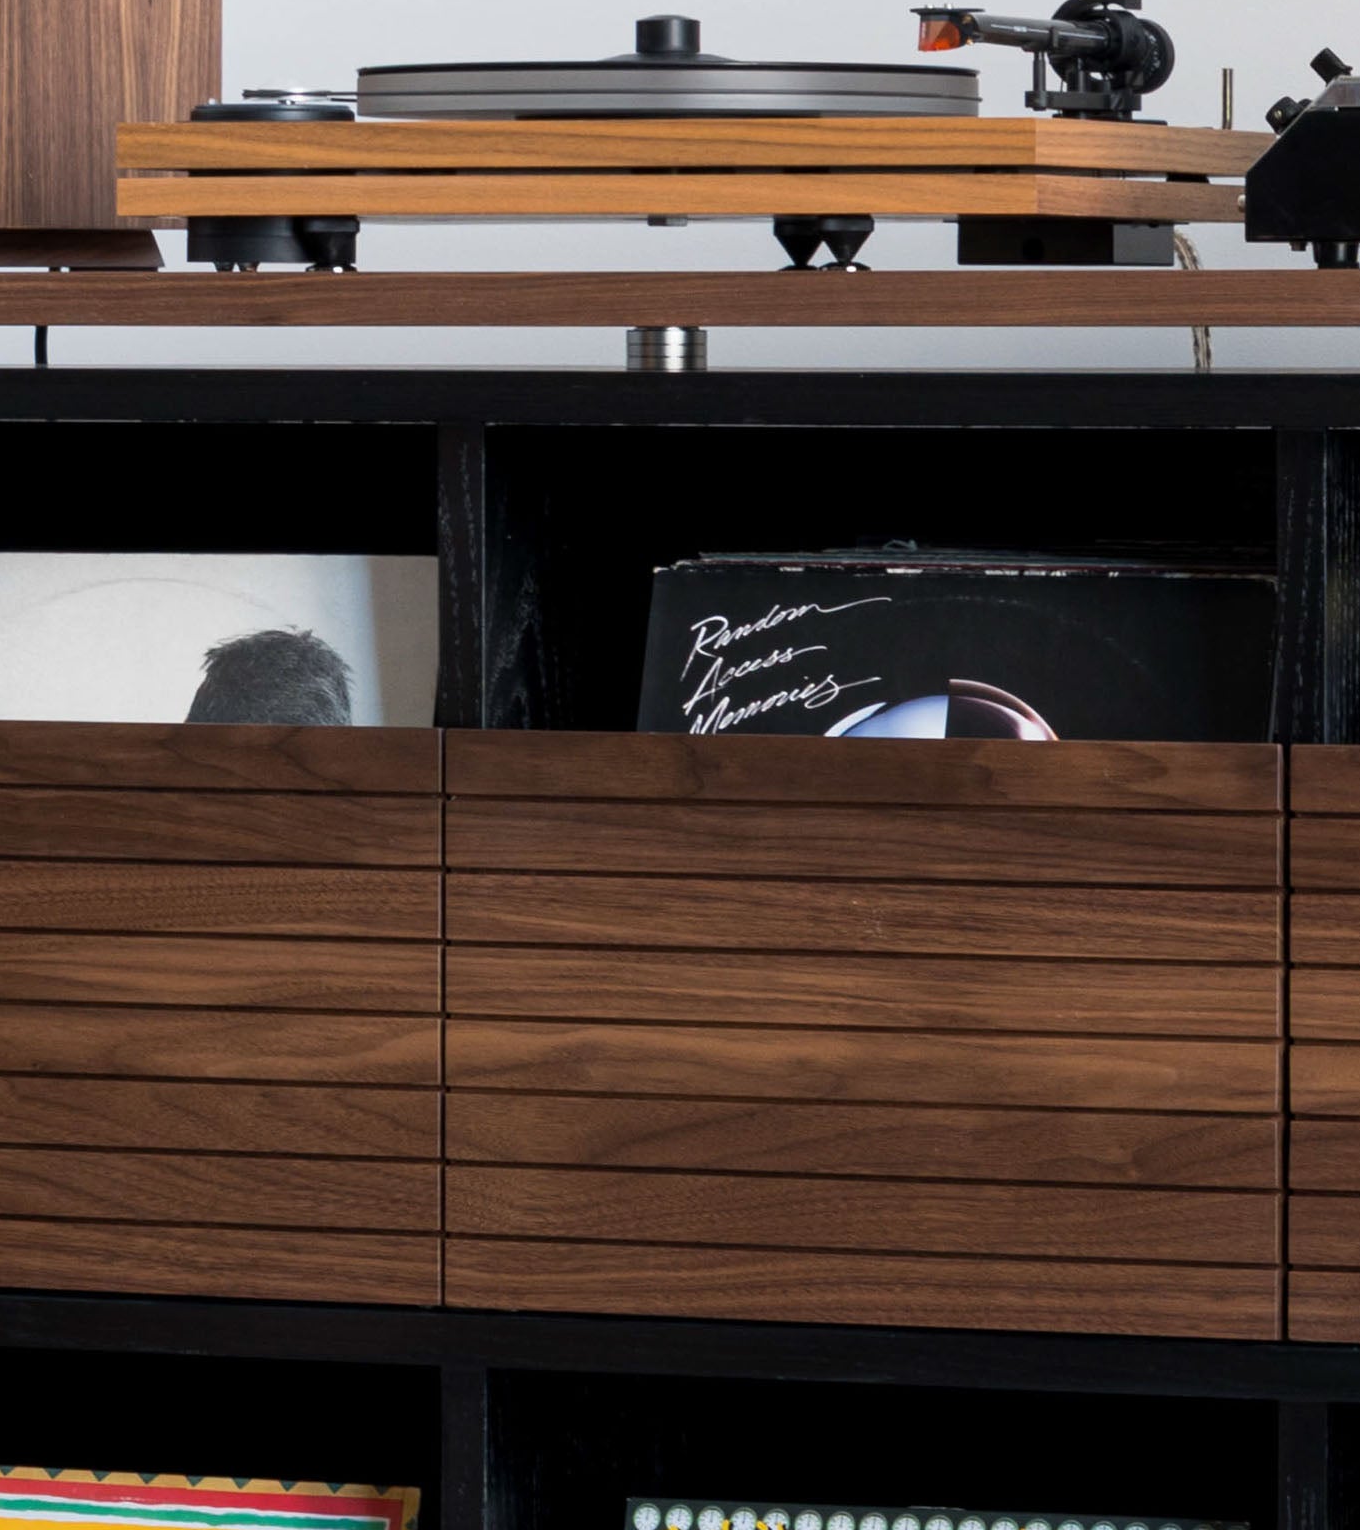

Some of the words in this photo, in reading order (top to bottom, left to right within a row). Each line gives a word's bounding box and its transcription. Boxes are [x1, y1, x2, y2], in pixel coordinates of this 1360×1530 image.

[680, 597, 892, 682] Random
[682, 645, 827, 715] Access
[689, 674, 882, 735] Memories
